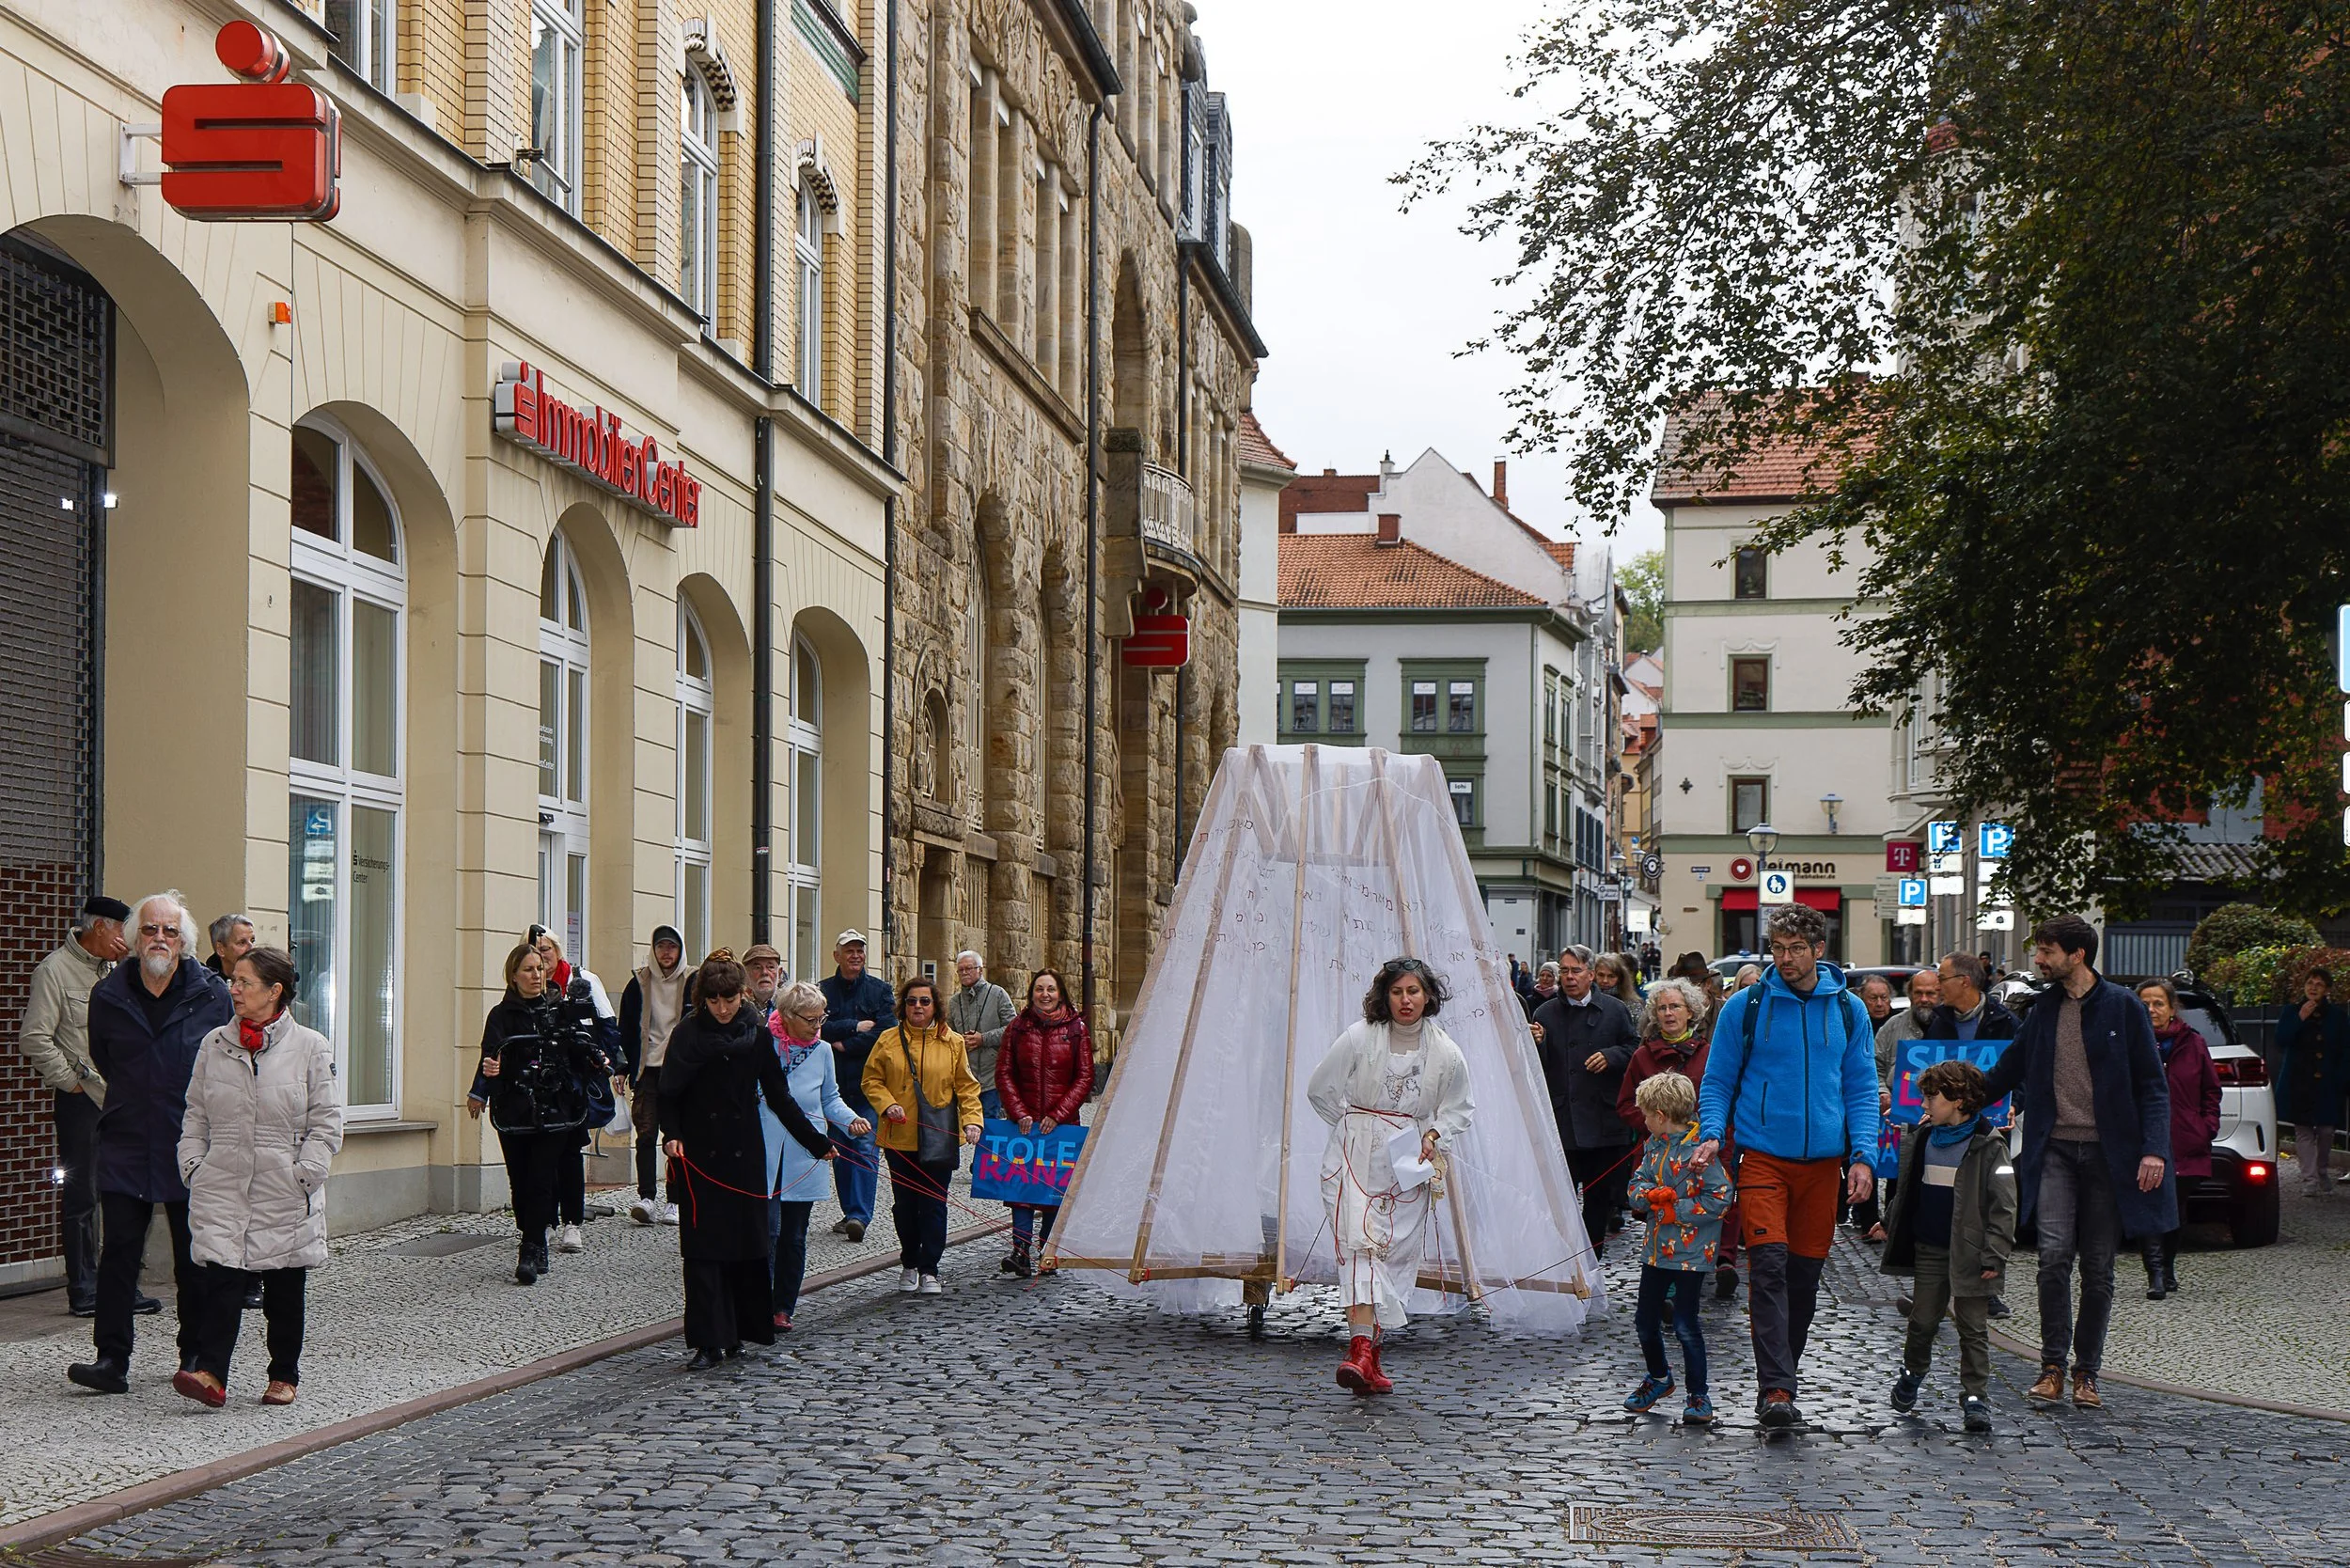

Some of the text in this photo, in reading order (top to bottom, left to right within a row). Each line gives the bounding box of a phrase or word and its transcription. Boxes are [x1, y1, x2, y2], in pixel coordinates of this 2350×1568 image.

[536, 369, 702, 528] ImmobilienCenter
[1757, 857, 1836, 873] eimann
[1904, 882, 1920, 902] P
[985, 1135, 1076, 1168] TOLE
